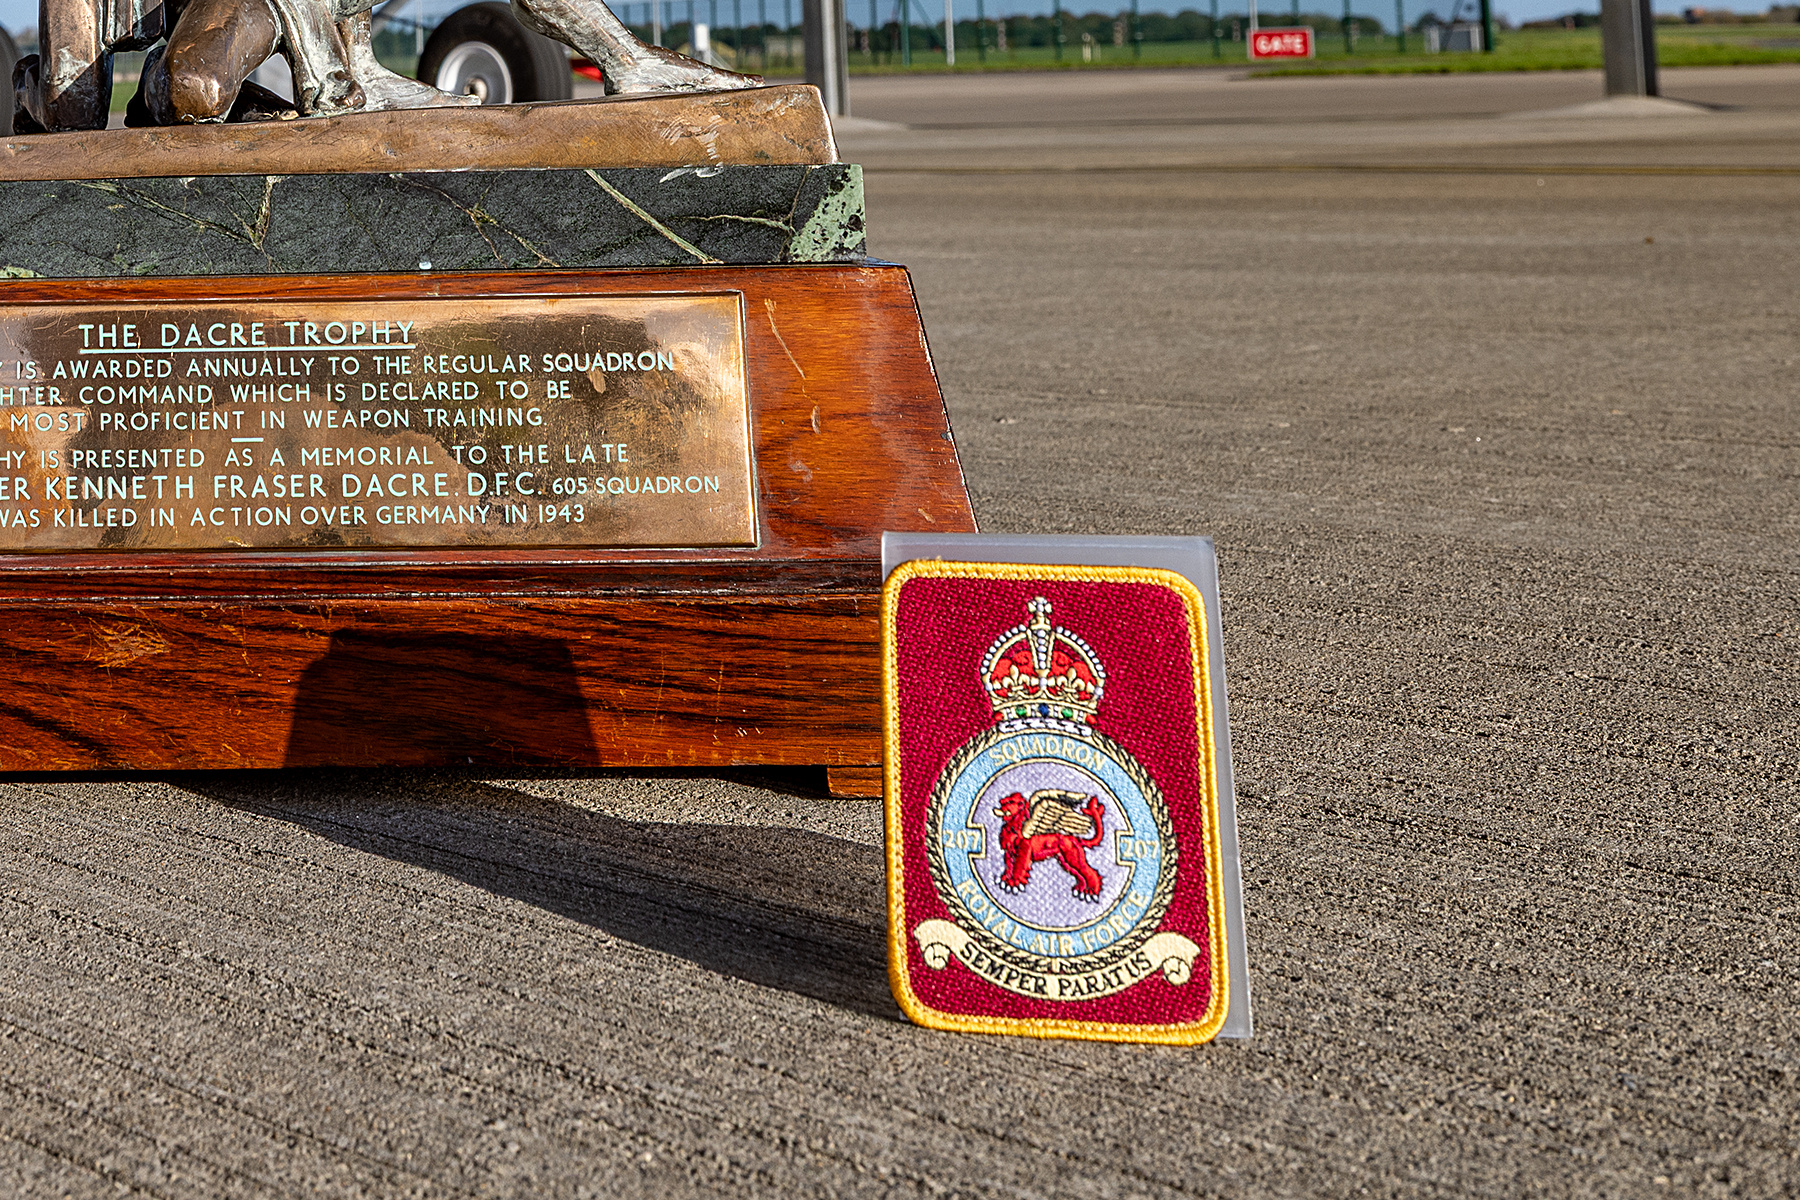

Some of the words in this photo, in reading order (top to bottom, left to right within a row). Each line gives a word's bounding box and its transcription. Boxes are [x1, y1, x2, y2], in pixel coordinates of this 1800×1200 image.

[1255, 34, 1305, 54] GATE
[78, 324, 140, 348] THE
[162, 323, 266, 347] DACRE
[284, 320, 416, 345] TROPHY
[15, 362, 36, 380] IS
[53, 359, 171, 379] AWARDED
[186, 357, 314, 377] ANNUALLY
[328, 357, 359, 375] TO
[373, 356, 411, 374] THE
[424, 355, 532, 373] REGULAR
[543, 352, 673, 372] SQUADRON
[79, 385, 212, 404] COMMAND
[230, 384, 310, 402] WHICH
[327, 383, 345, 401] IS
[362, 382, 479, 400] DECLARED
[496, 381, 528, 399] TO
[547, 380, 571, 398] BE
[11, 413, 85, 432] MOST
[101, 411, 244, 431] PROFICIENT
[261, 410, 284, 429] IN
[303, 409, 409, 428] WEAPON
[41, 450, 59, 468] IS
[73, 449, 204, 468] PRESENTED
[225, 448, 253, 466] AS
[270, 448, 285, 466] A
[301, 446, 433, 466] MEMORIAL
[452, 446, 486, 464] TO
[501, 445, 549, 464] THE
[565, 444, 628, 463] LATE
[46, 475, 193, 500] KENNETH
[214, 474, 326, 498] FRASER
[468, 472, 542, 496] D.F.C.
[553, 477, 588, 494] 605
[596, 476, 719, 494] SQUADRON
[54, 508, 137, 527] KILLED
[151, 508, 174, 526] IN
[190, 507, 290, 526] ACTION
[301, 506, 367, 525] OVER
[376, 505, 489, 524] GERMANY
[505, 504, 527, 523] IN
[539, 504, 584, 523] 1943
[988, 733, 1106, 770] SQUADRON
[943, 829, 982, 850] 207
[1120, 837, 1160, 860] 207
[957, 877, 1023, 947] ROYAL
[1029, 932, 1074, 956] AIR
[1081, 889, 1149, 952] FORCE
[960, 940, 1048, 996] SEMPER
[1058, 950, 1152, 996] PARATUS
